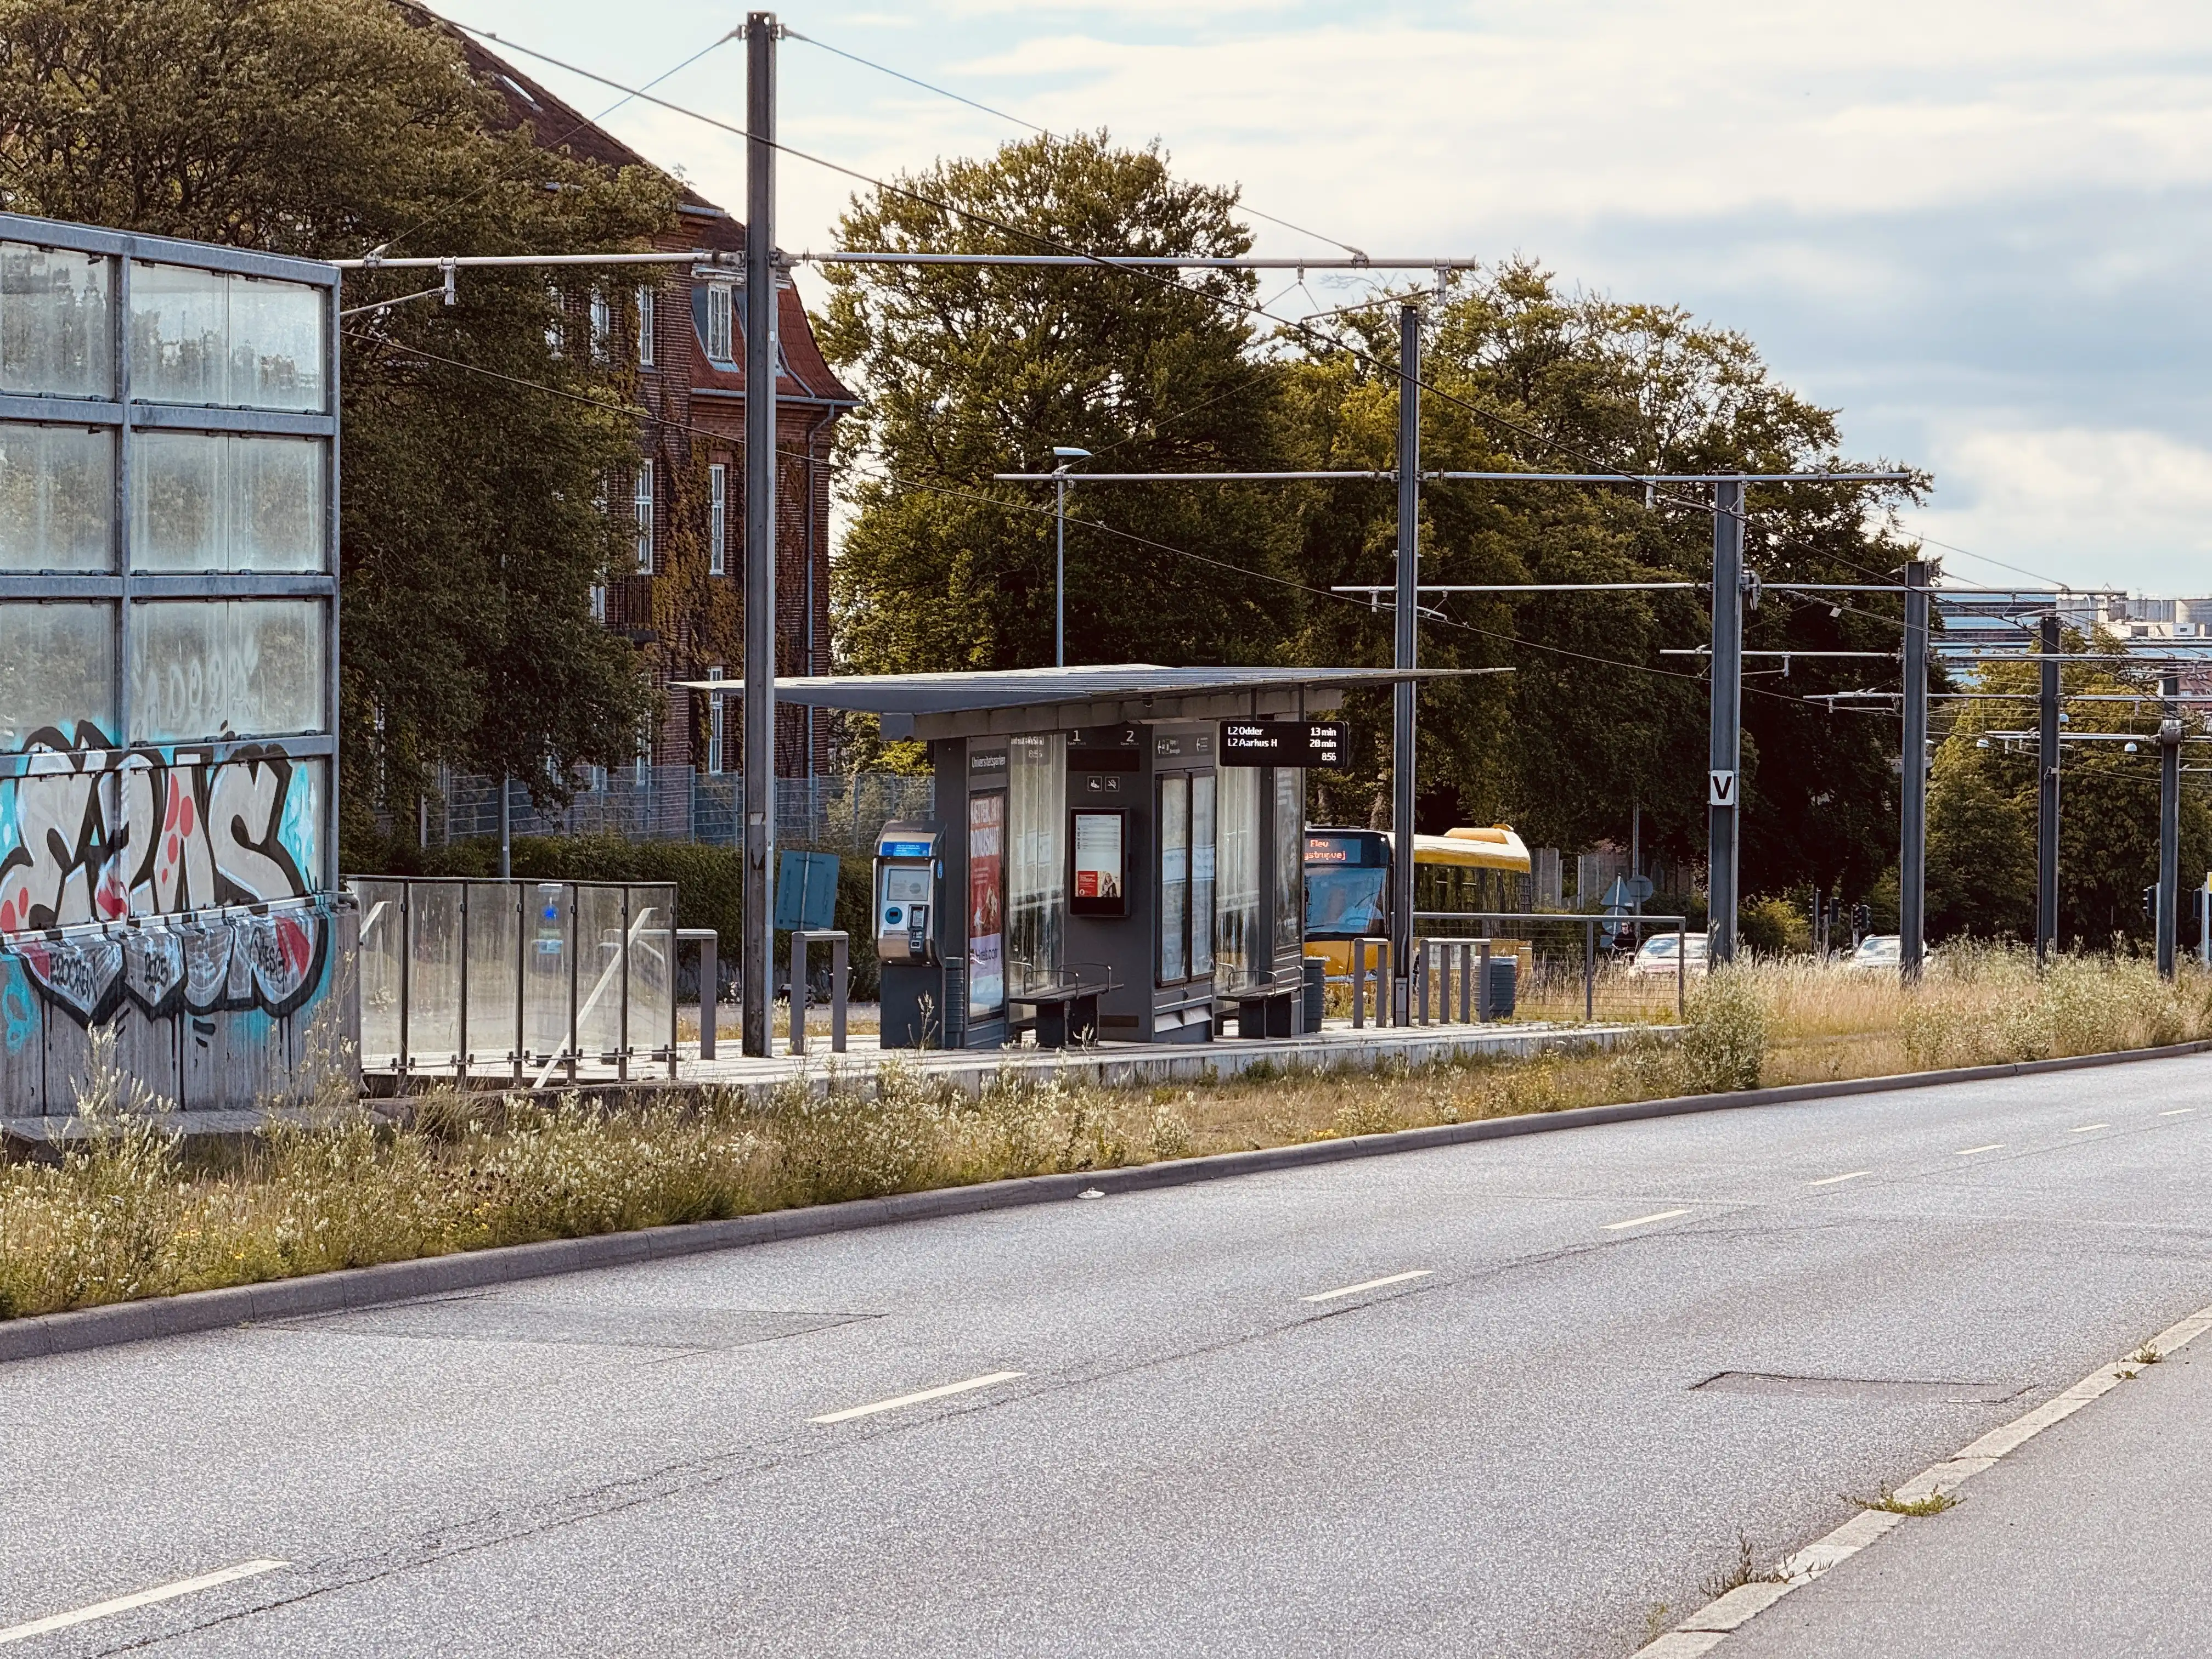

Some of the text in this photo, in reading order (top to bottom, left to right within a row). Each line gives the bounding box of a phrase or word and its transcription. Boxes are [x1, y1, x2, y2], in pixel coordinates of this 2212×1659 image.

[1073, 730, 1081, 742] 1
[1126, 730, 1134, 742] 2
[1227, 726, 1336, 736] L2 Odder 13 min
[1227, 738, 1336, 748] L2 Aarhus H 20 min
[1712, 776, 1732, 799] V
[1304, 850, 1346, 861] ystrupvej
